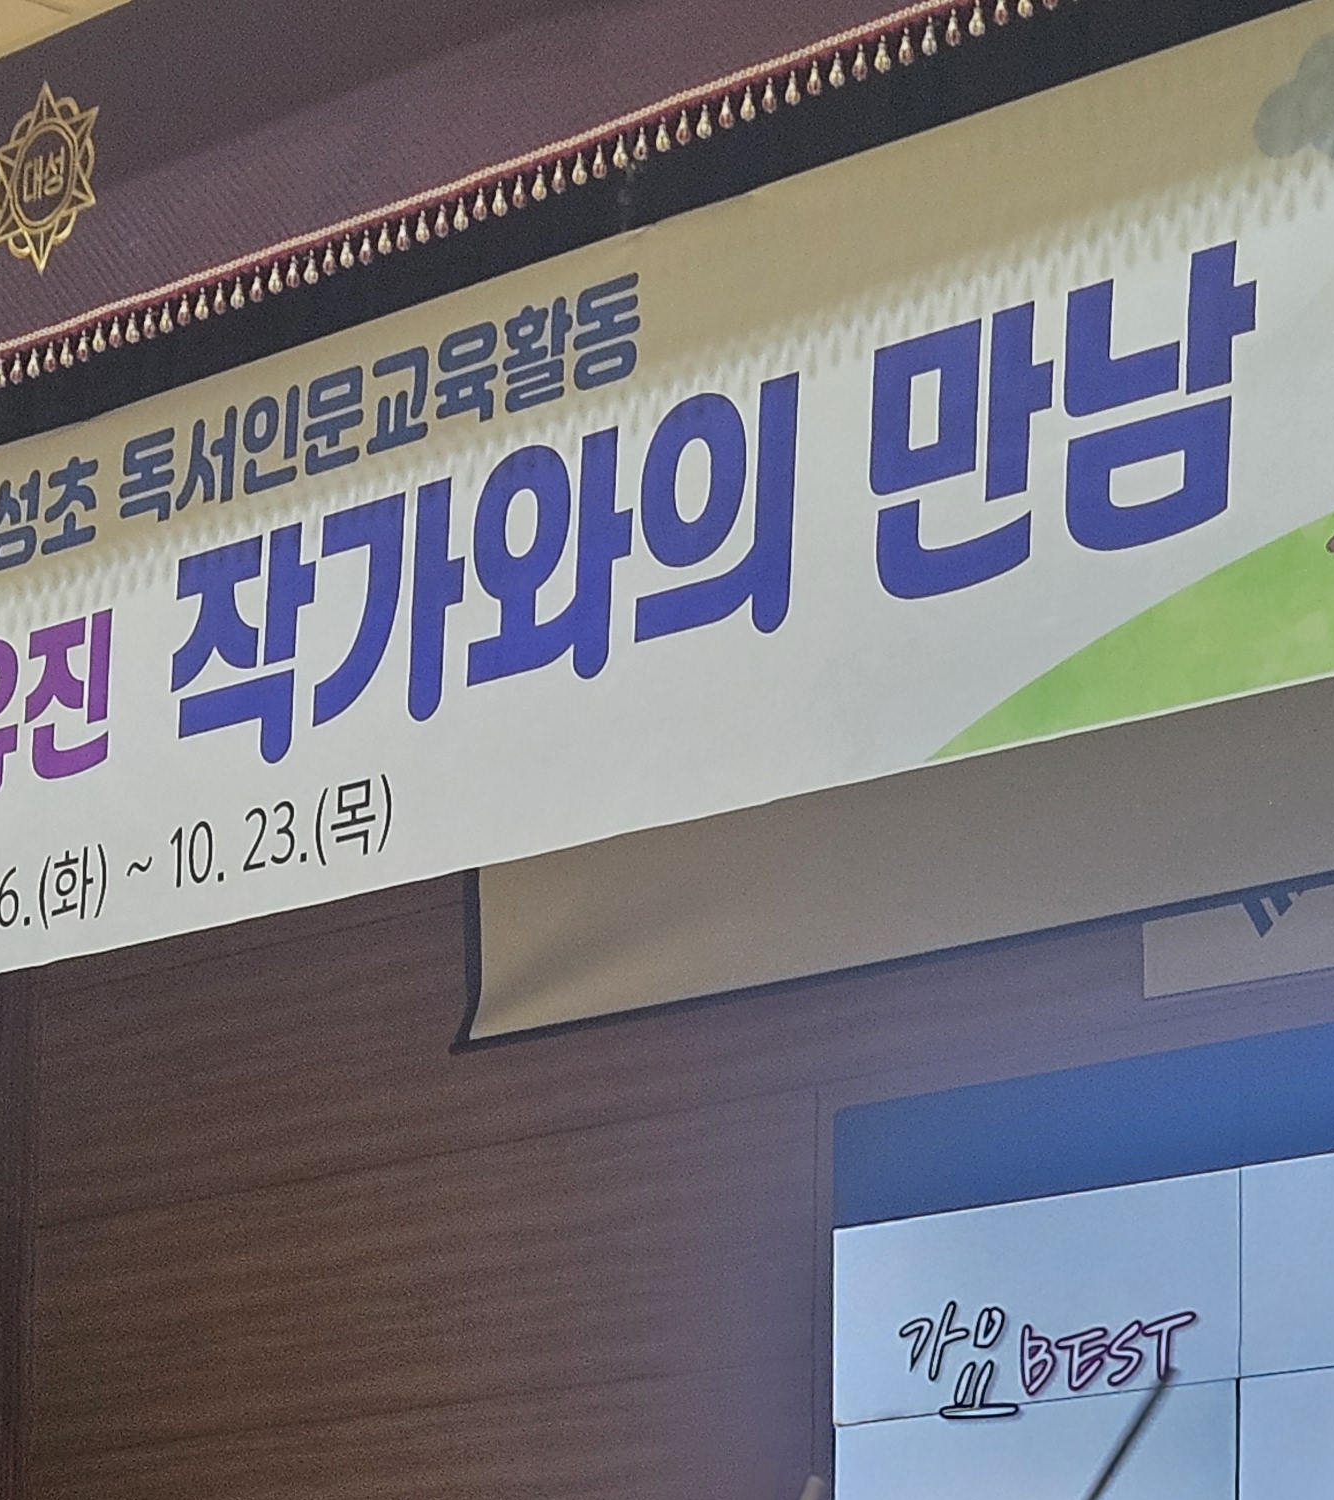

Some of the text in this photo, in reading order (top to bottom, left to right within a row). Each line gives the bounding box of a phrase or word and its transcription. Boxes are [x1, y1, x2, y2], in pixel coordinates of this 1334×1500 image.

[22, 145, 66, 204] 대성
[118, 271, 642, 523] 독서인문교육활동
[169, 372, 800, 764] 작가와의
[870, 239, 1258, 601] 만남
[170, 820, 226, 888] 10.
[242, 773, 393, 873] 23.(목)
